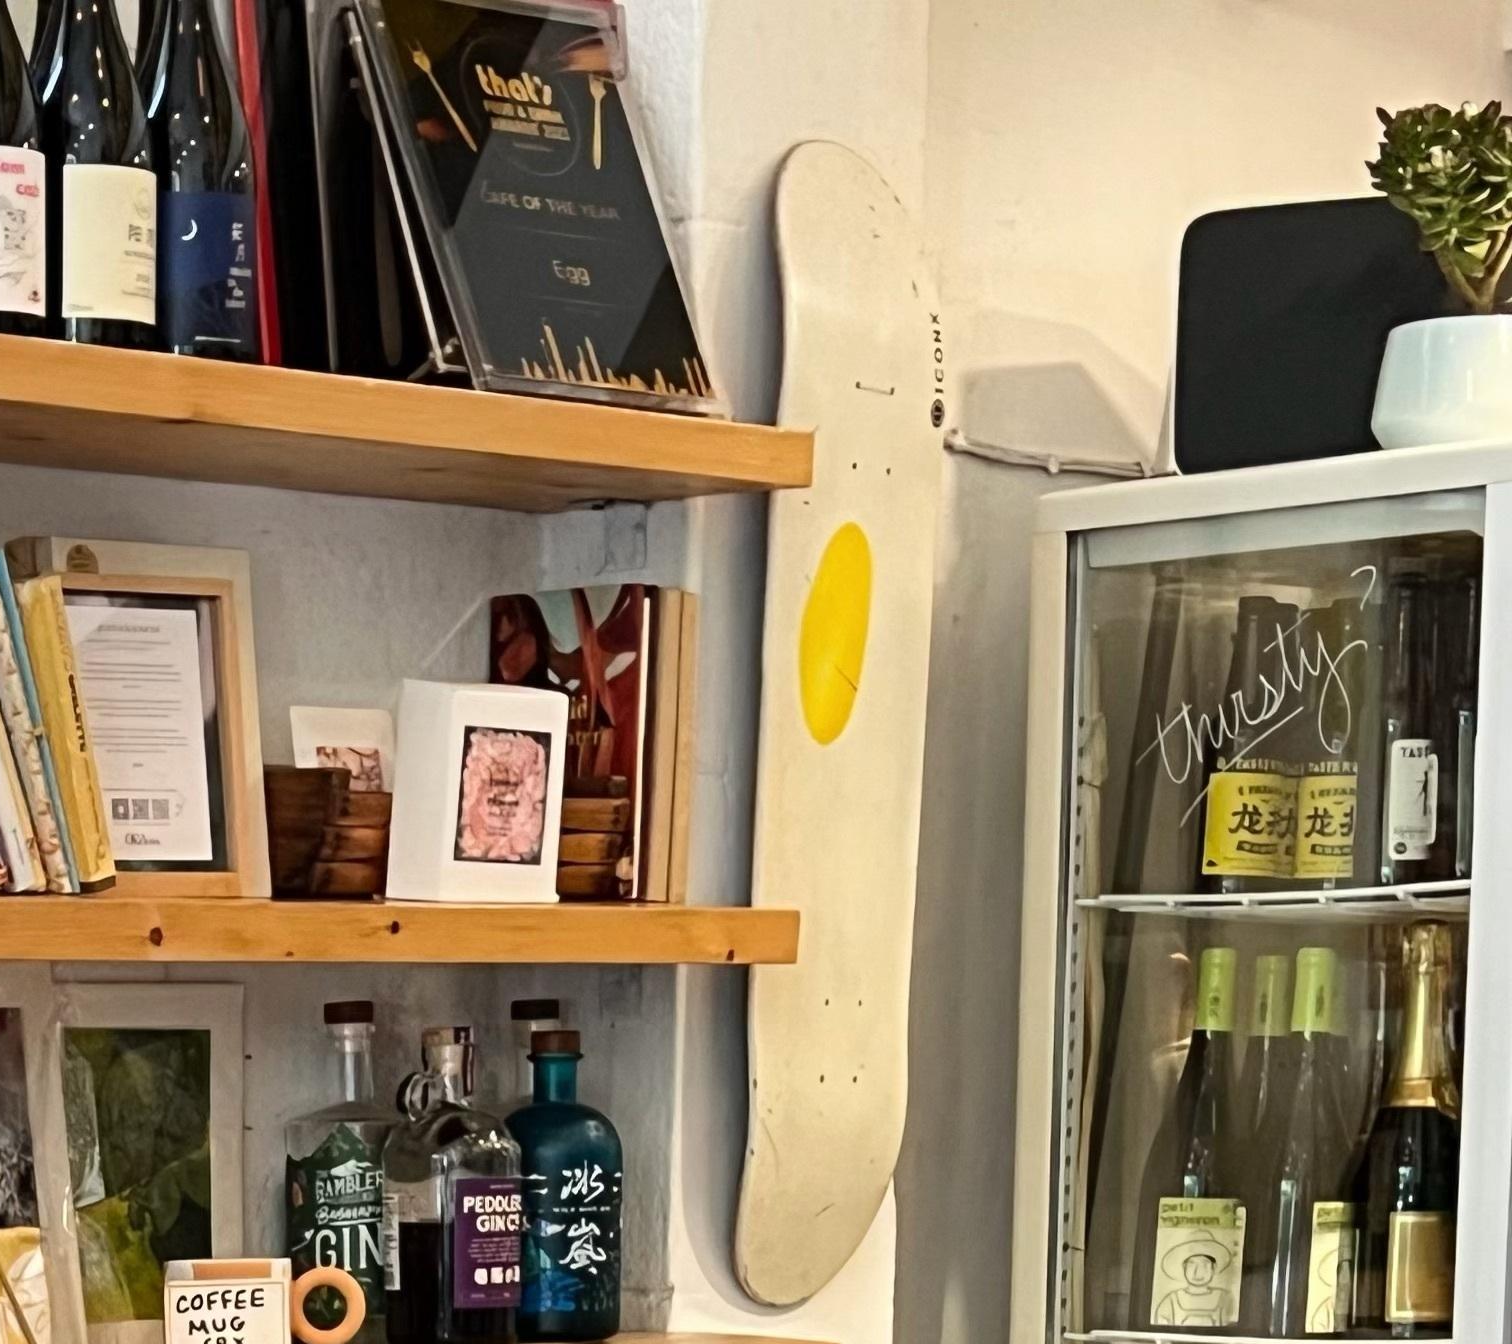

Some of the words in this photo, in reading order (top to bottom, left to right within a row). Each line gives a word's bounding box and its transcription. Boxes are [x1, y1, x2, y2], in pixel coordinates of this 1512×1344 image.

[475, 63, 553, 107] that's
[552, 259, 591, 287] Egg
[315, 1223, 384, 1272] GIN
[176, 1288, 265, 1314] COFFEE
[188, 1316, 246, 1336] MUG
